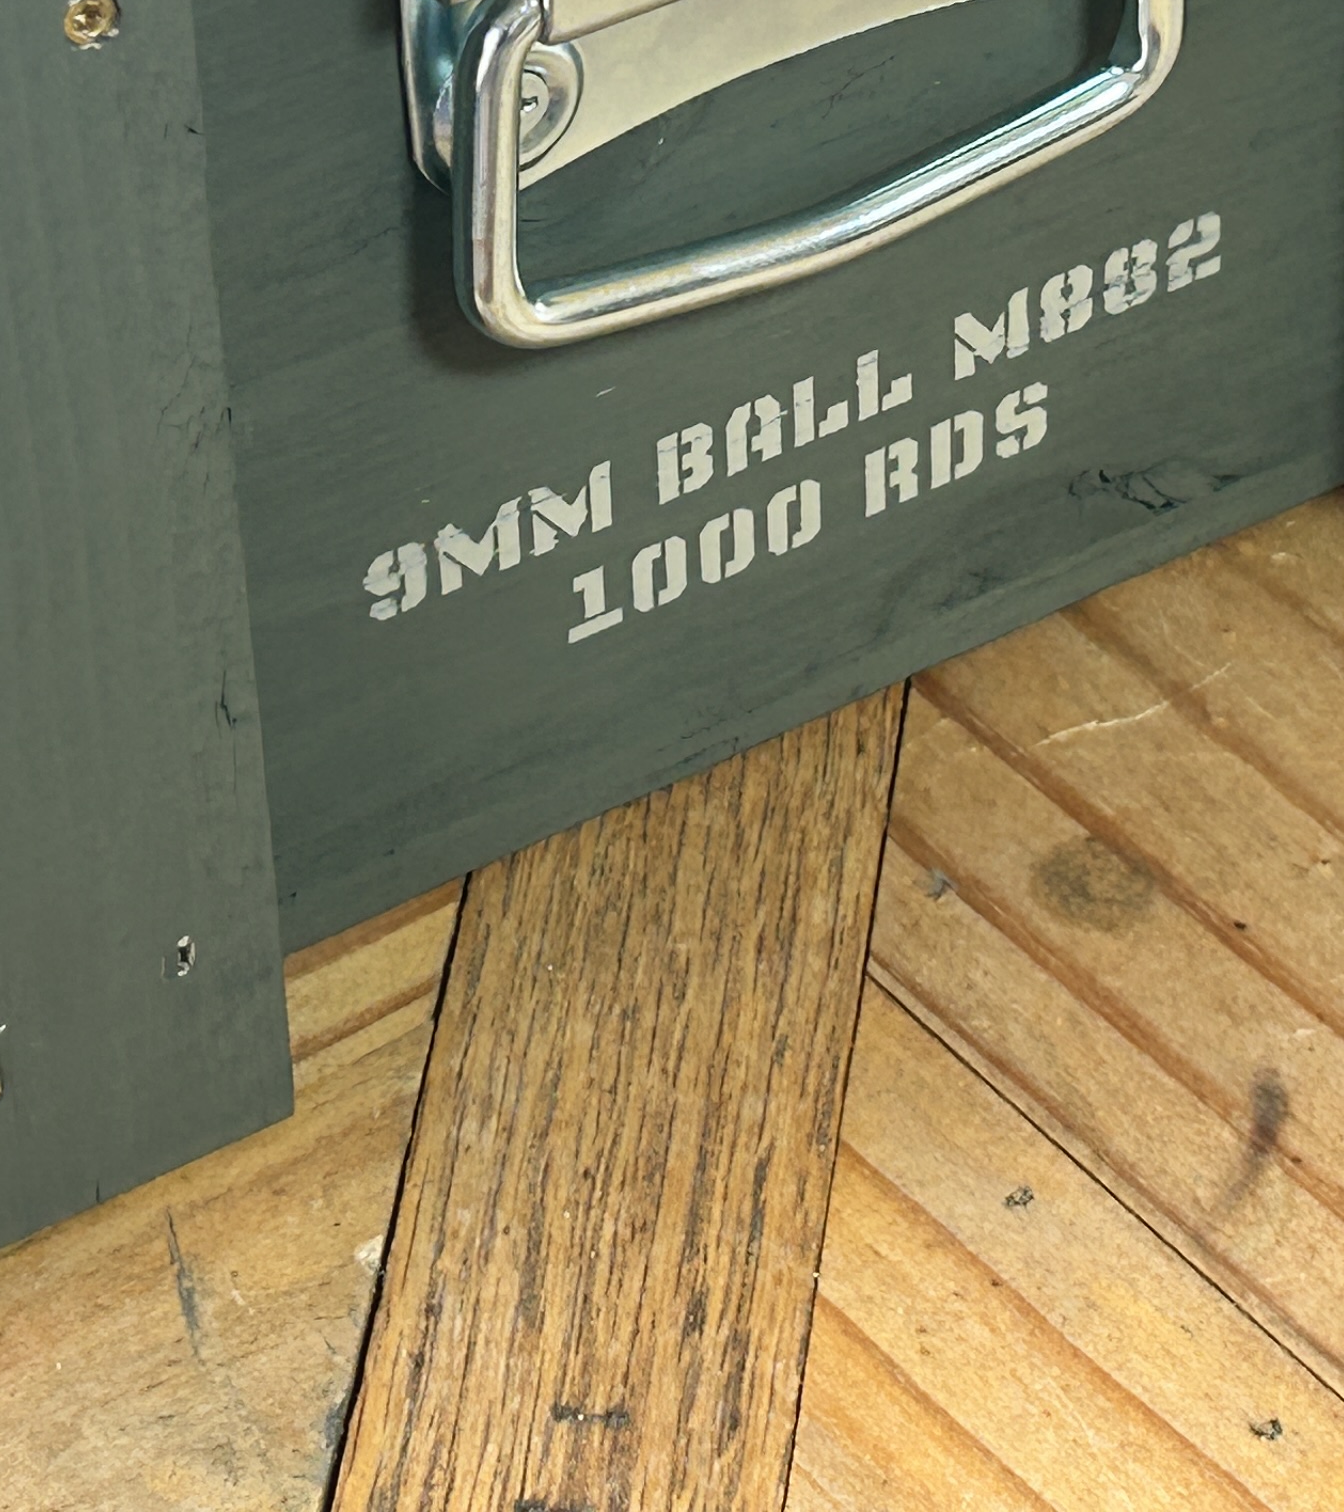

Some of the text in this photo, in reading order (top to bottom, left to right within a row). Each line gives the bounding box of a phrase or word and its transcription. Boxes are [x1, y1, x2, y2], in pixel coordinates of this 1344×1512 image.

[362, 211, 1222, 621] 9MM BALL M882
[568, 381, 1049, 644] 1000 RDS
